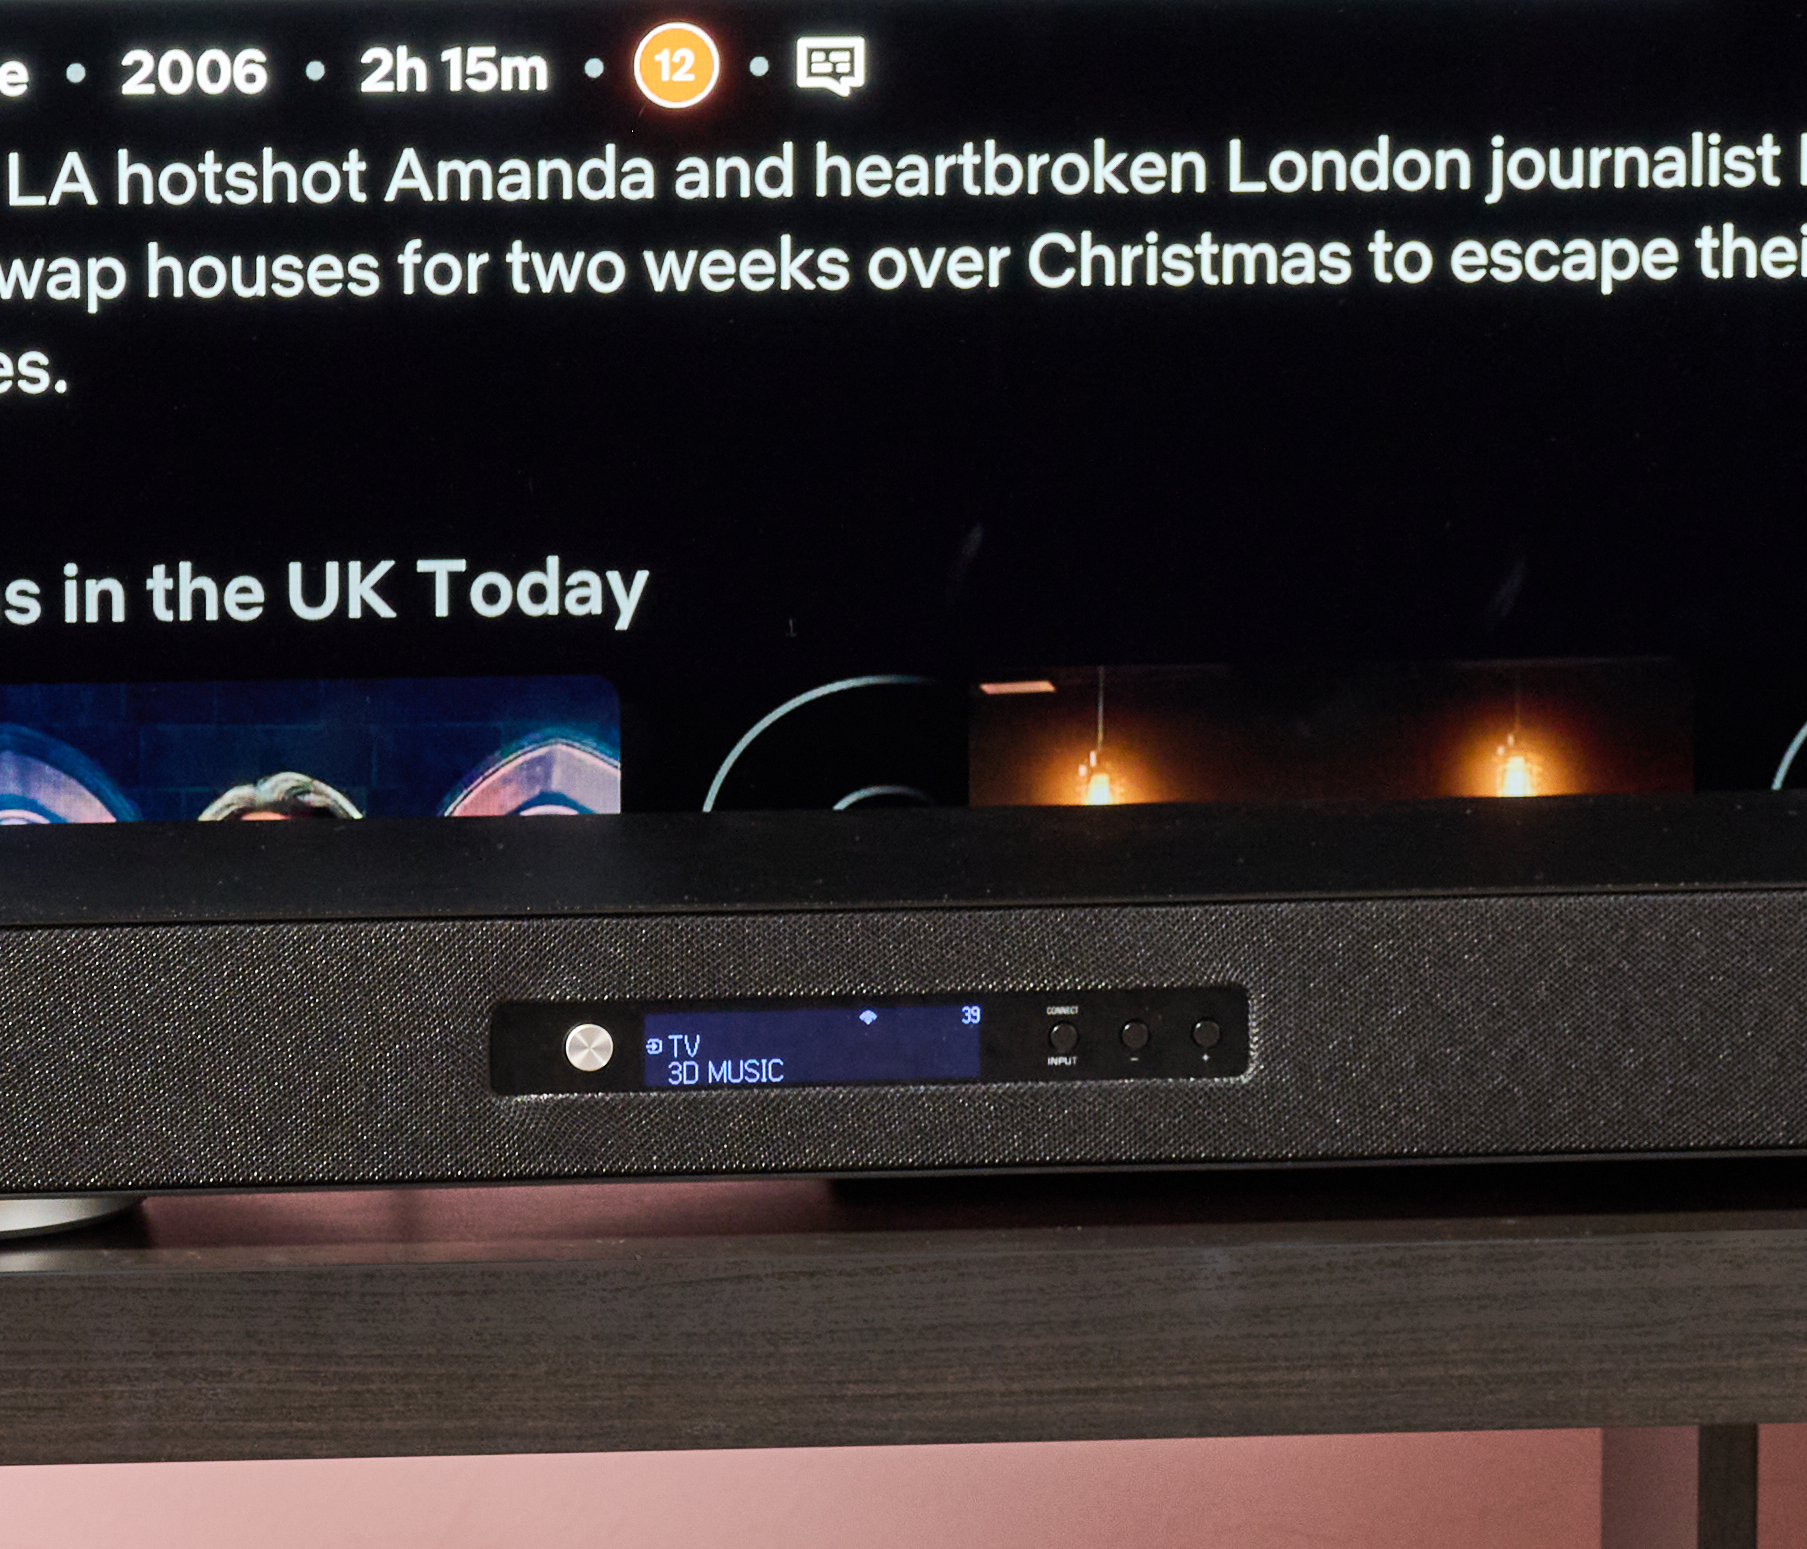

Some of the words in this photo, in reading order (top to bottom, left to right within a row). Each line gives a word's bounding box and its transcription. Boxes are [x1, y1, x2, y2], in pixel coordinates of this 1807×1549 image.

[121, 48, 268, 95] 2006
[361, 45, 429, 92] 2h
[441, 46, 549, 92] 15m
[655, 50, 697, 83] 12
[9, 152, 98, 206] LA
[118, 147, 367, 205] hotshot
[384, 143, 654, 202] Amanda
[675, 141, 793, 199] and
[816, 138, 1206, 197] heartbroken
[1229, 135, 1470, 193] London
[1485, 132, 1781, 204] journalist
[148, 242, 380, 298] houses
[397, 239, 489, 295] for
[506, 240, 625, 294] two
[643, 234, 849, 292] weeks
[868, 246, 1011, 290] over
[1029, 230, 1351, 288] Christmas
[1368, 230, 1433, 283] to
[1451, 238, 1679, 295] escape
[64, 563, 125, 623] in
[146, 561, 264, 621] the
[289, 560, 396, 620] UK
[417, 556, 649, 630] Today
[961, 1006, 981, 1024] 39
[668, 1034, 700, 1058] TV
[1047, 1056, 1078, 1066] INPUT
[668, 1061, 699, 1085] 3D
[707, 1058, 784, 1084] MUSIC
